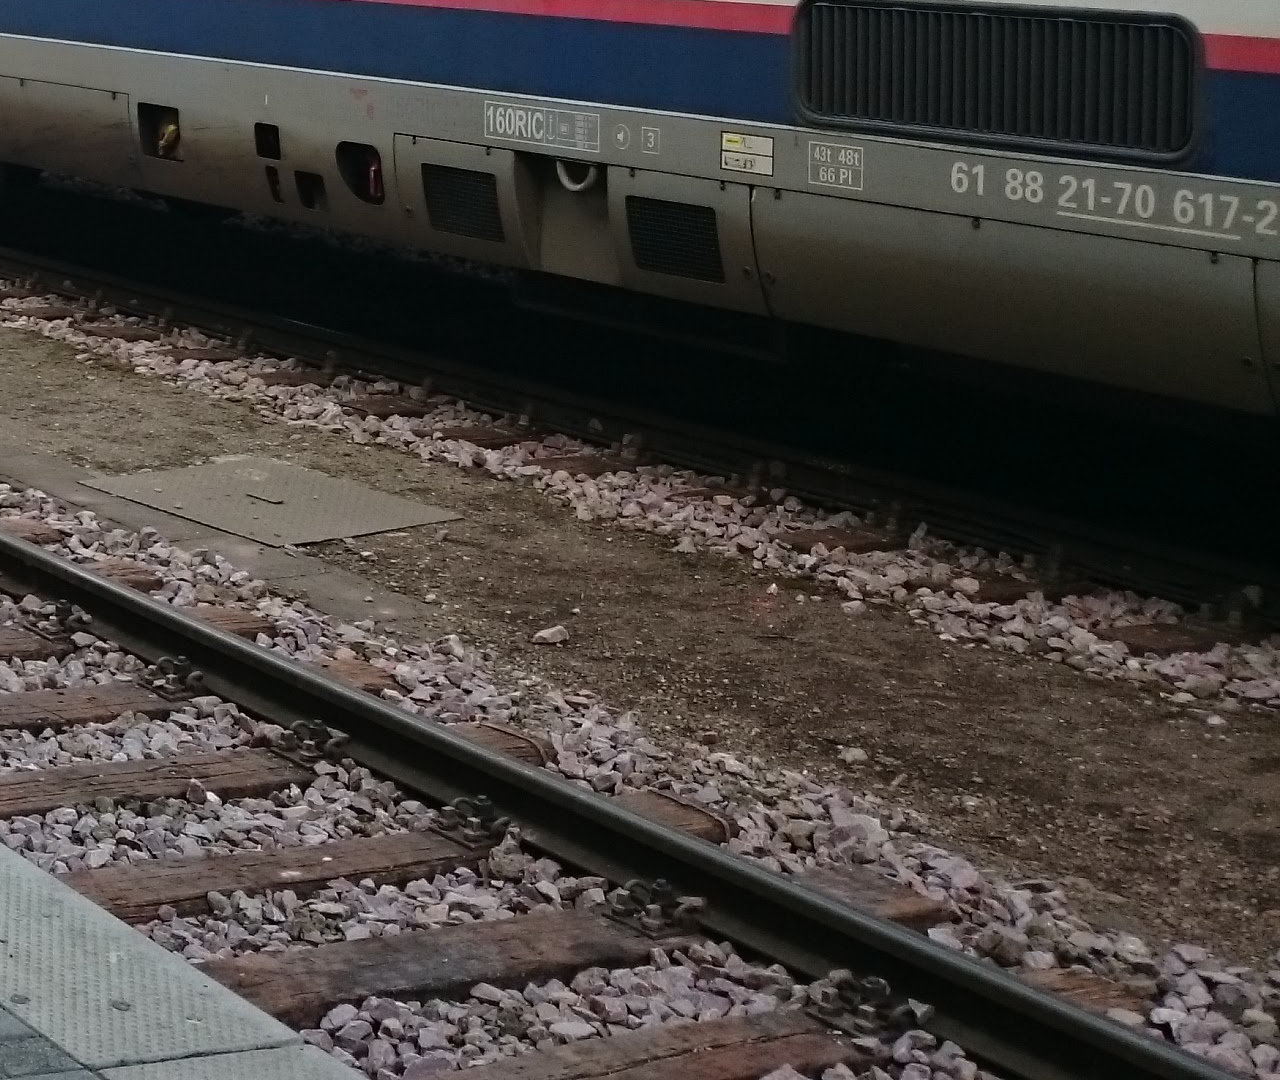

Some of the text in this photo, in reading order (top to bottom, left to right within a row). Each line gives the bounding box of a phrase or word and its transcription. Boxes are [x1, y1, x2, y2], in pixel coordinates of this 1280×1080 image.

[647, 132, 655, 148] 3
[814, 146, 860, 167] 43t 48t
[819, 166, 836, 183] 66
[950, 161, 1279, 237] 61 88 21-70 617-2
